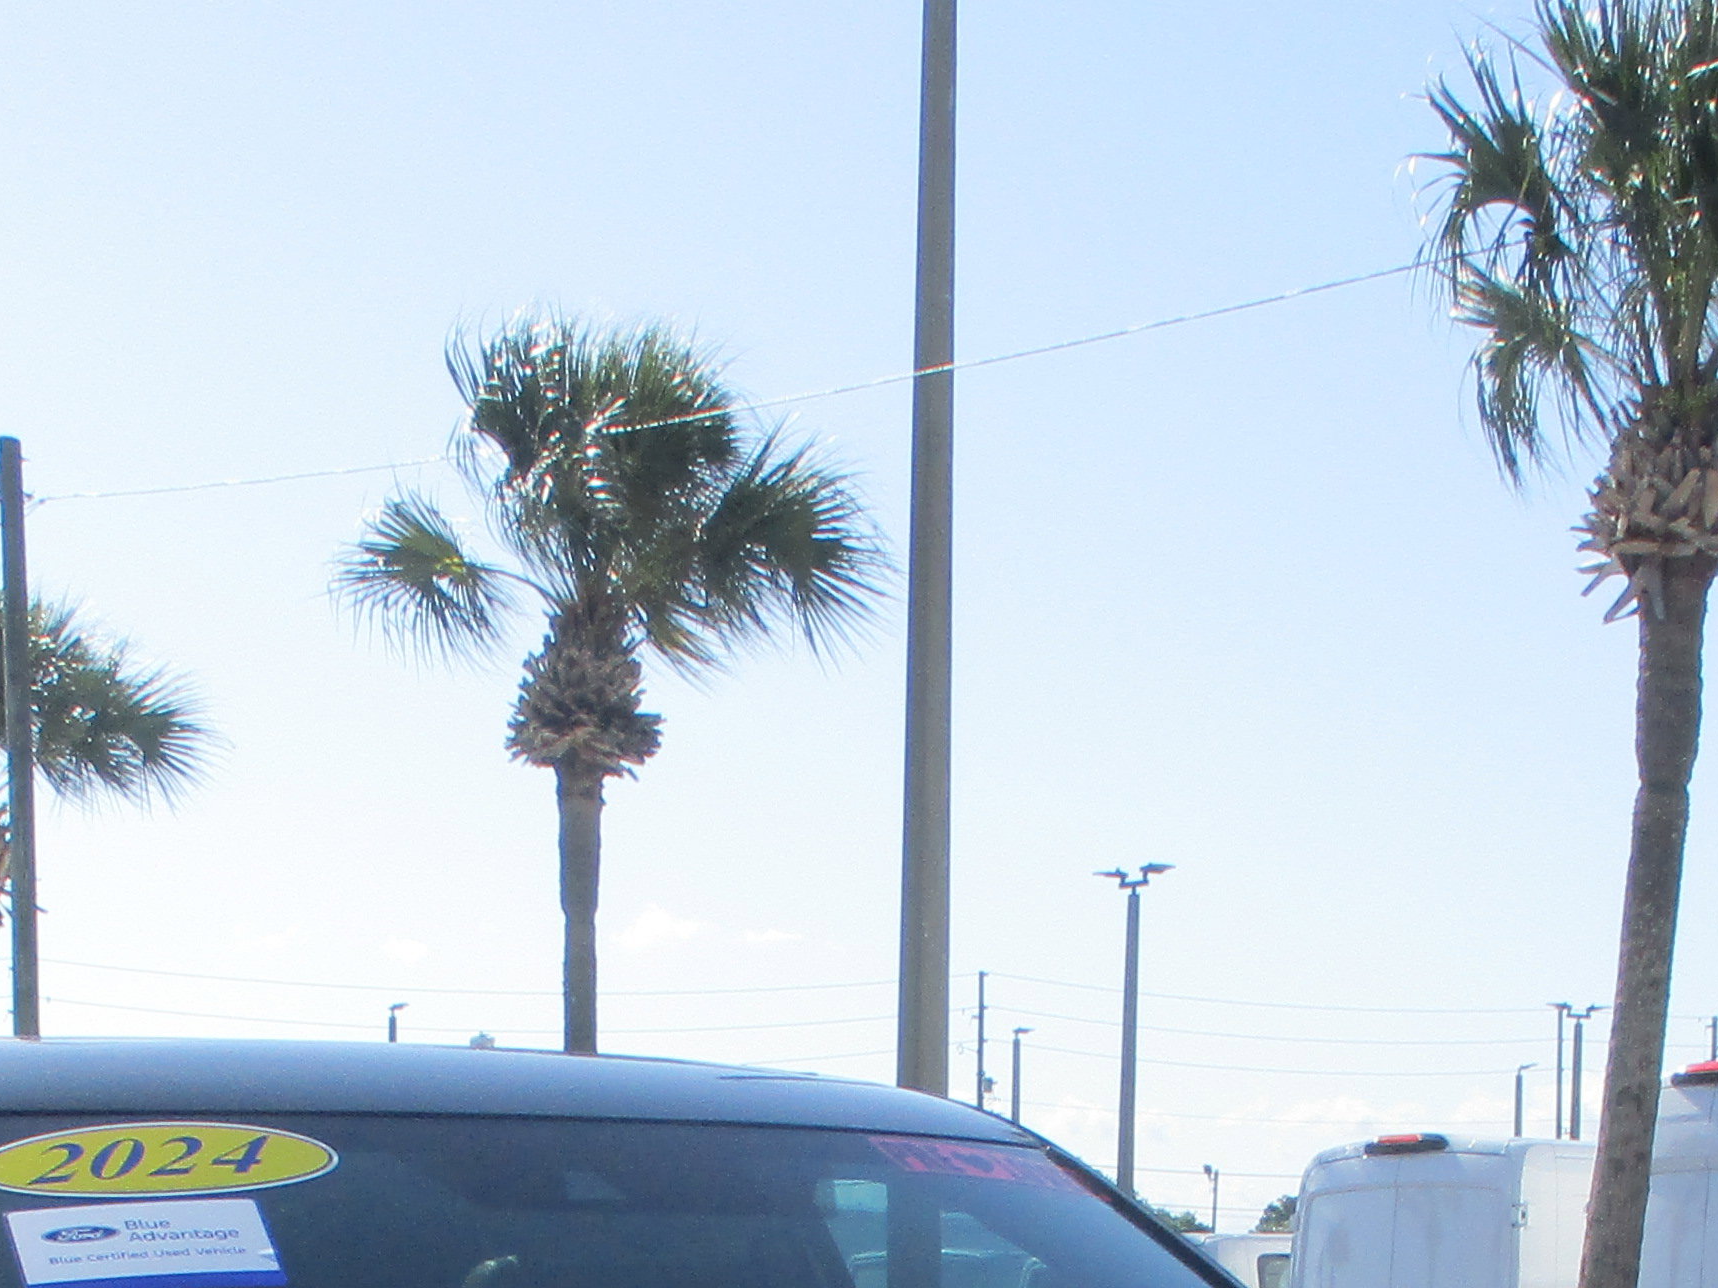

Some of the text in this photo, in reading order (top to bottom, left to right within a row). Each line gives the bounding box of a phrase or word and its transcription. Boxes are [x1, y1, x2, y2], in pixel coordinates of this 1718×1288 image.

[28, 1135, 270, 1186] 2024
[124, 1218, 172, 1231] Blue
[128, 1227, 240, 1243] Advantage
[48, 1244, 247, 1265] Blue Certified Used Vehicle
